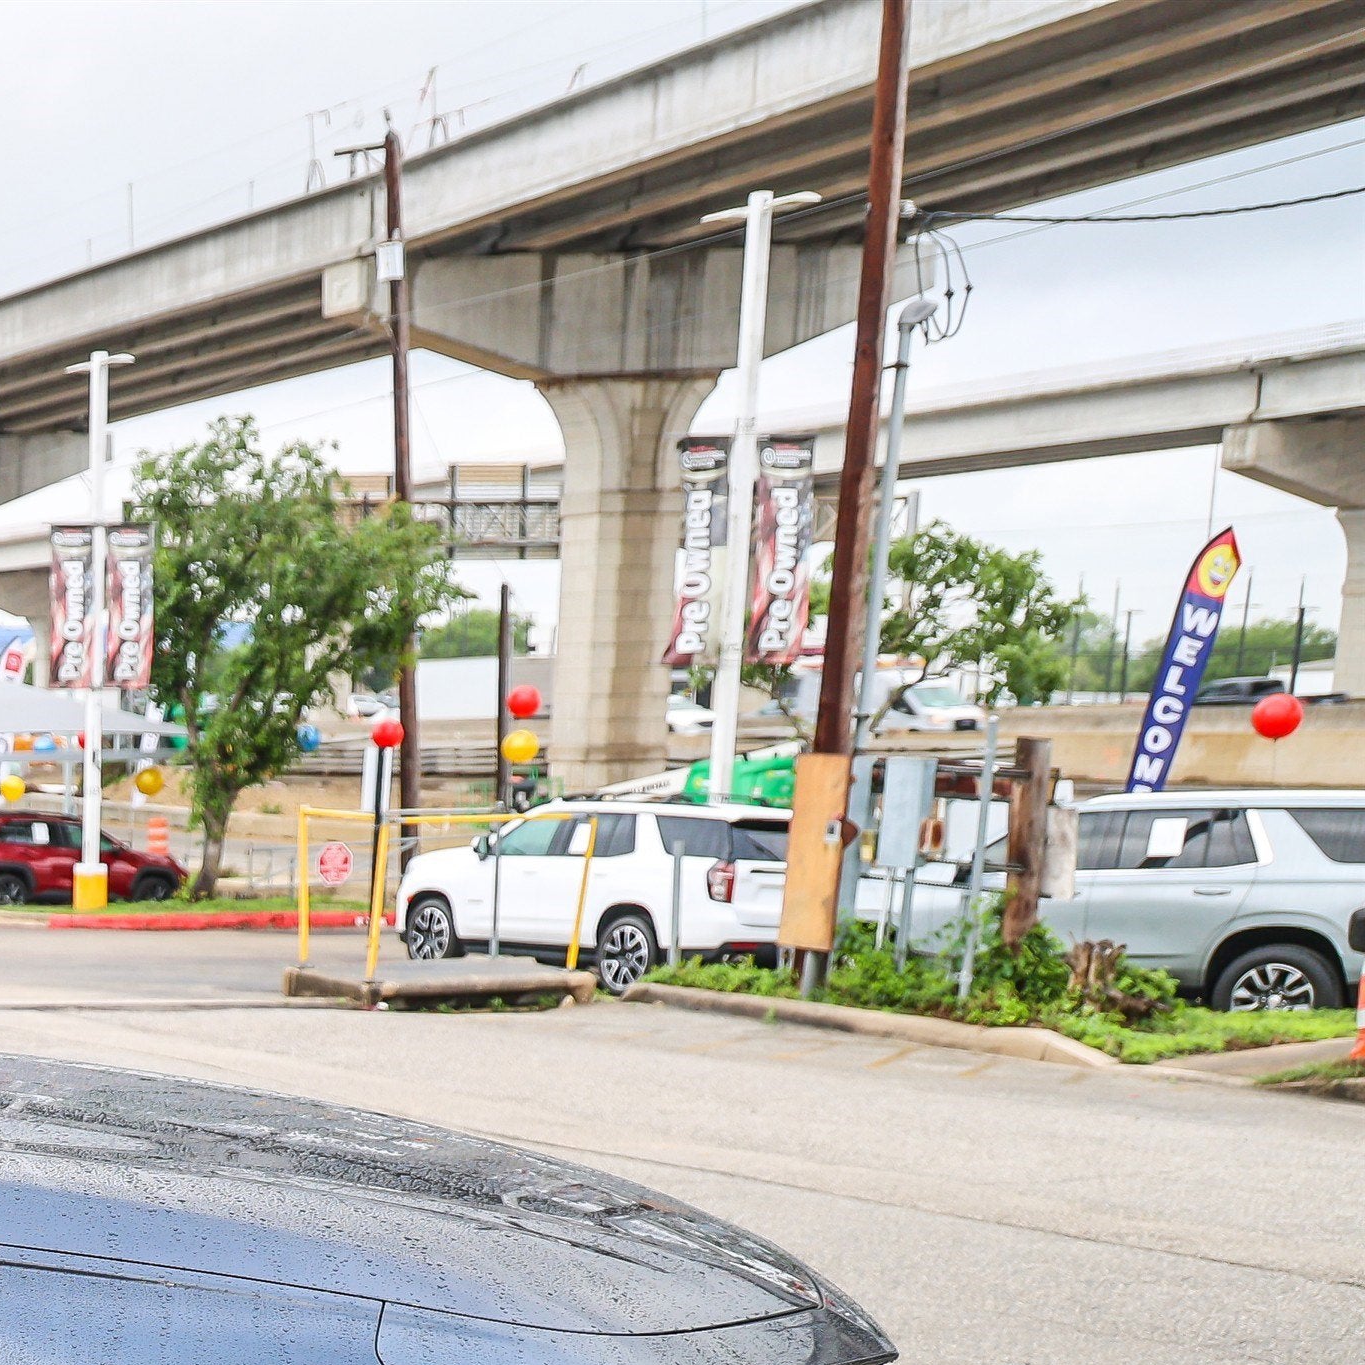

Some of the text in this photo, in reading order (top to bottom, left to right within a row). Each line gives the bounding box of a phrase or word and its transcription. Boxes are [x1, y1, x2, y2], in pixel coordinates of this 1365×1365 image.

[683, 489, 713, 598] Owned
[768, 487, 799, 596] Owned
[63, 560, 84, 641] Owned
[117, 560, 141, 641] Owned
[675, 600, 710, 654] Pre
[758, 598, 793, 652] Pre
[58, 641, 83, 682] Pre
[114, 641, 140, 682] Pre
